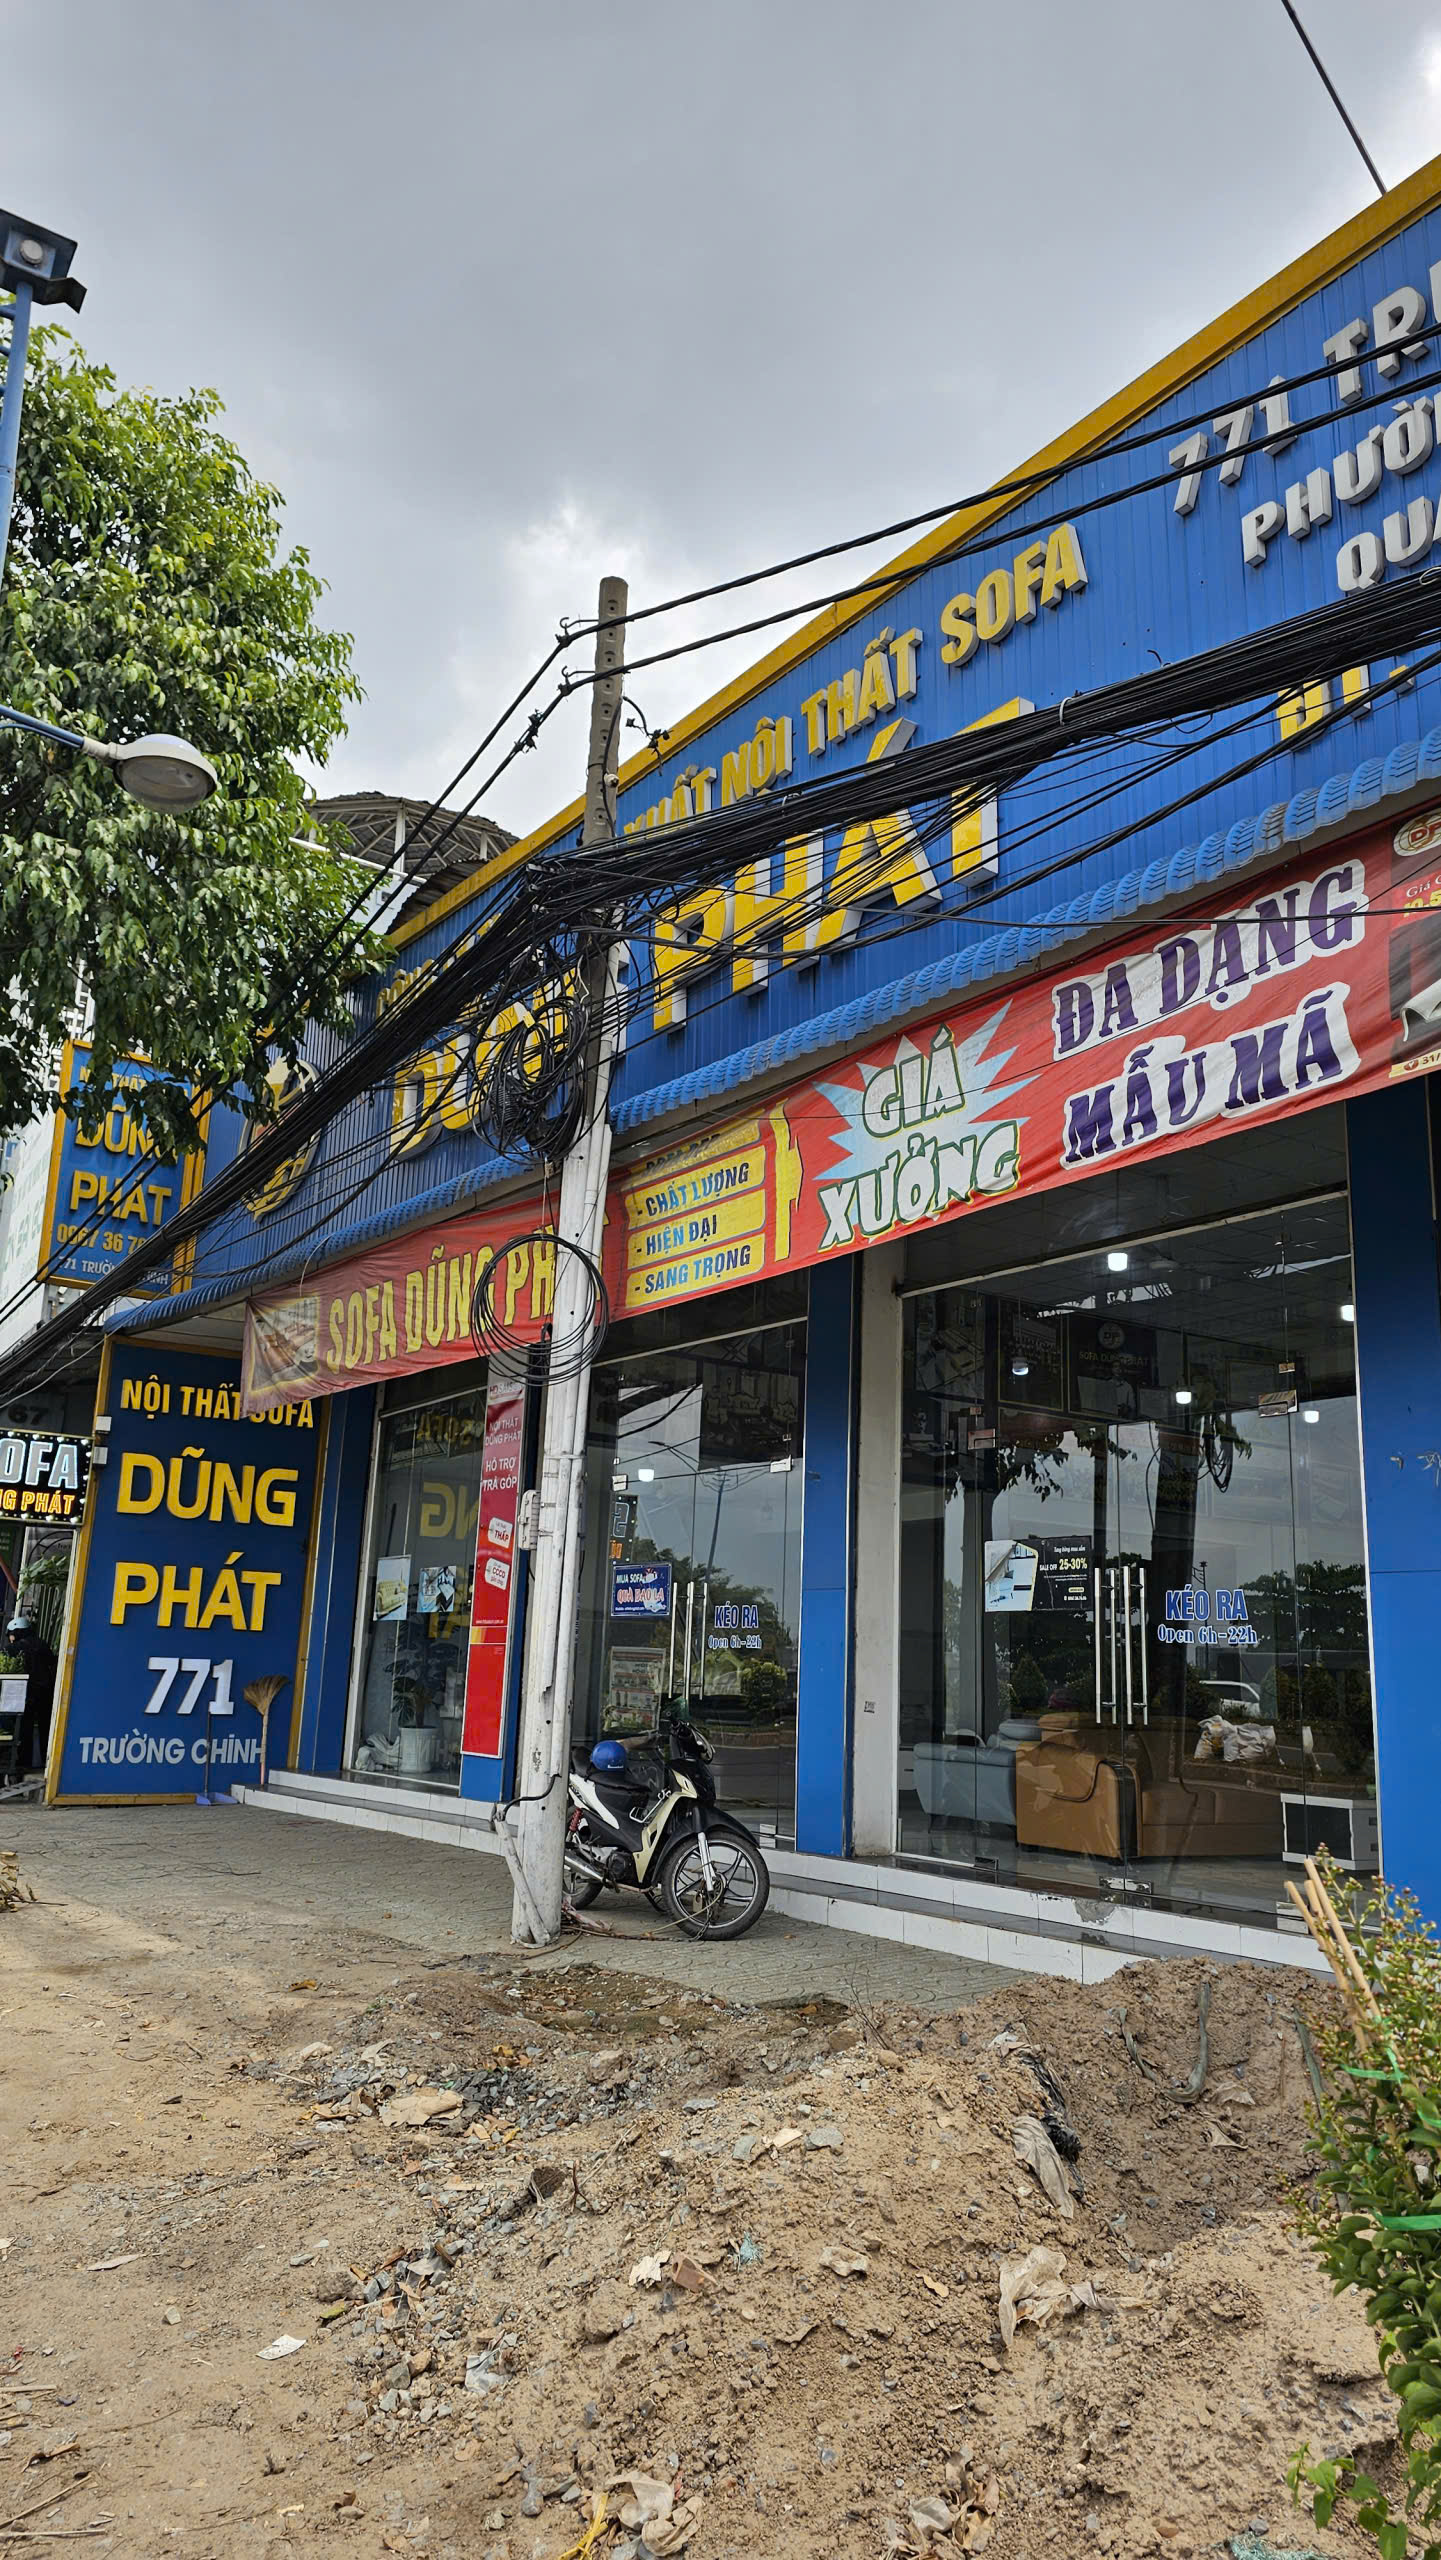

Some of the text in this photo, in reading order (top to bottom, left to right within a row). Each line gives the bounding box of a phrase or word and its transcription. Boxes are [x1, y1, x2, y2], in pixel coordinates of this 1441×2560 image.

[1169, 260, 1441, 516] 771 TR
[1241, 392, 1441, 566] PHƯỜ
[1336, 495, 1441, 591] QU
[721, 715, 792, 806] NỘI
[801, 627, 923, 757] THẤT
[940, 522, 1088, 667] SOFA
[653, 696, 1035, 1035] PHÁT
[1056, 865, 1359, 1056] ĐA DẠNG
[861, 1022, 966, 1139] GIÁ
[1064, 989, 1345, 1165] MẪU MÃ
[69, 1168, 172, 1227] PHÁT
[645, 1181, 689, 1217] CHẤT
[690, 1162, 750, 1201] LƯỢNG
[817, 1118, 1022, 1253] XƯỞNG
[102, 1230, 124, 1253] 36
[646, 1225, 685, 1256] HIỆN
[688, 1214, 718, 1243] ĐẠI
[644, 1263, 690, 1294] SANG
[692, 1244, 752, 1279] TRỌNG
[326, 1280, 398, 1374] SOFA
[404, 1244, 496, 1354] DŨNG
[120, 1374, 171, 1420] NỘI
[180, 1381, 242, 1422] THẤT
[20, 1489, 76, 1516] PHÁT
[115, 1445, 300, 1528] DŨNG
[500, 1474, 517, 1490] GÓP
[109, 1551, 283, 1633] PHÁT
[1058, 1557, 1088, 1571] 25-30%
[714, 1600, 759, 1629] KÉO RA
[1165, 1583, 1249, 1621] KÉO RA
[707, 1634, 729, 1650] Open
[1157, 1623, 1258, 1645] Open 6h-22h
[144, 1656, 235, 1716] 771
[79, 1727, 186, 1765] TRƯỜNG
